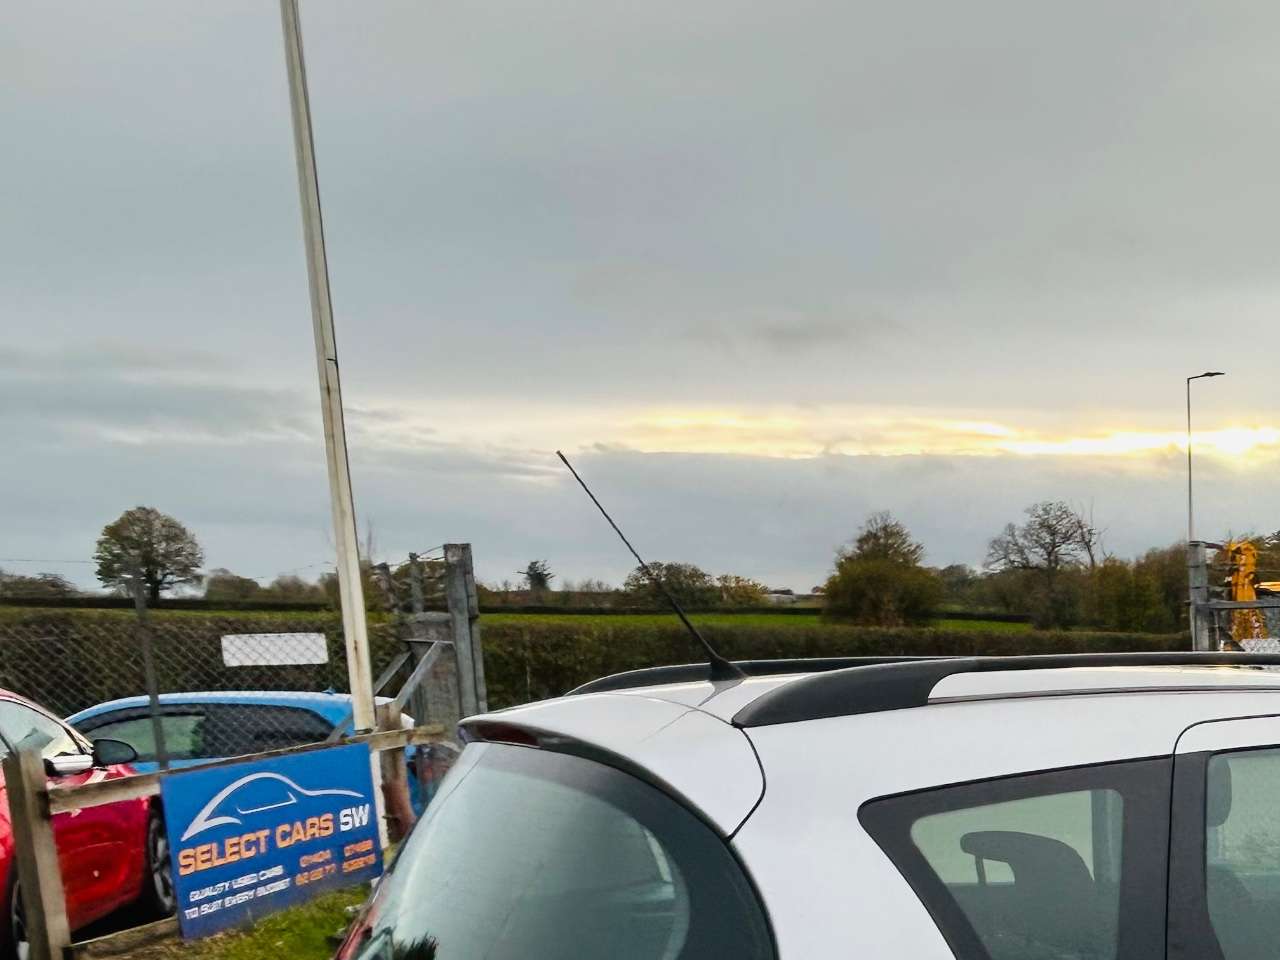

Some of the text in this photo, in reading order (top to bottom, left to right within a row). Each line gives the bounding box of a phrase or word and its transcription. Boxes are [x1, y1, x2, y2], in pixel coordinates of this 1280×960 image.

[178, 829, 270, 876] SELECT
[275, 813, 334, 849] CARS
[339, 804, 370, 832] SW
